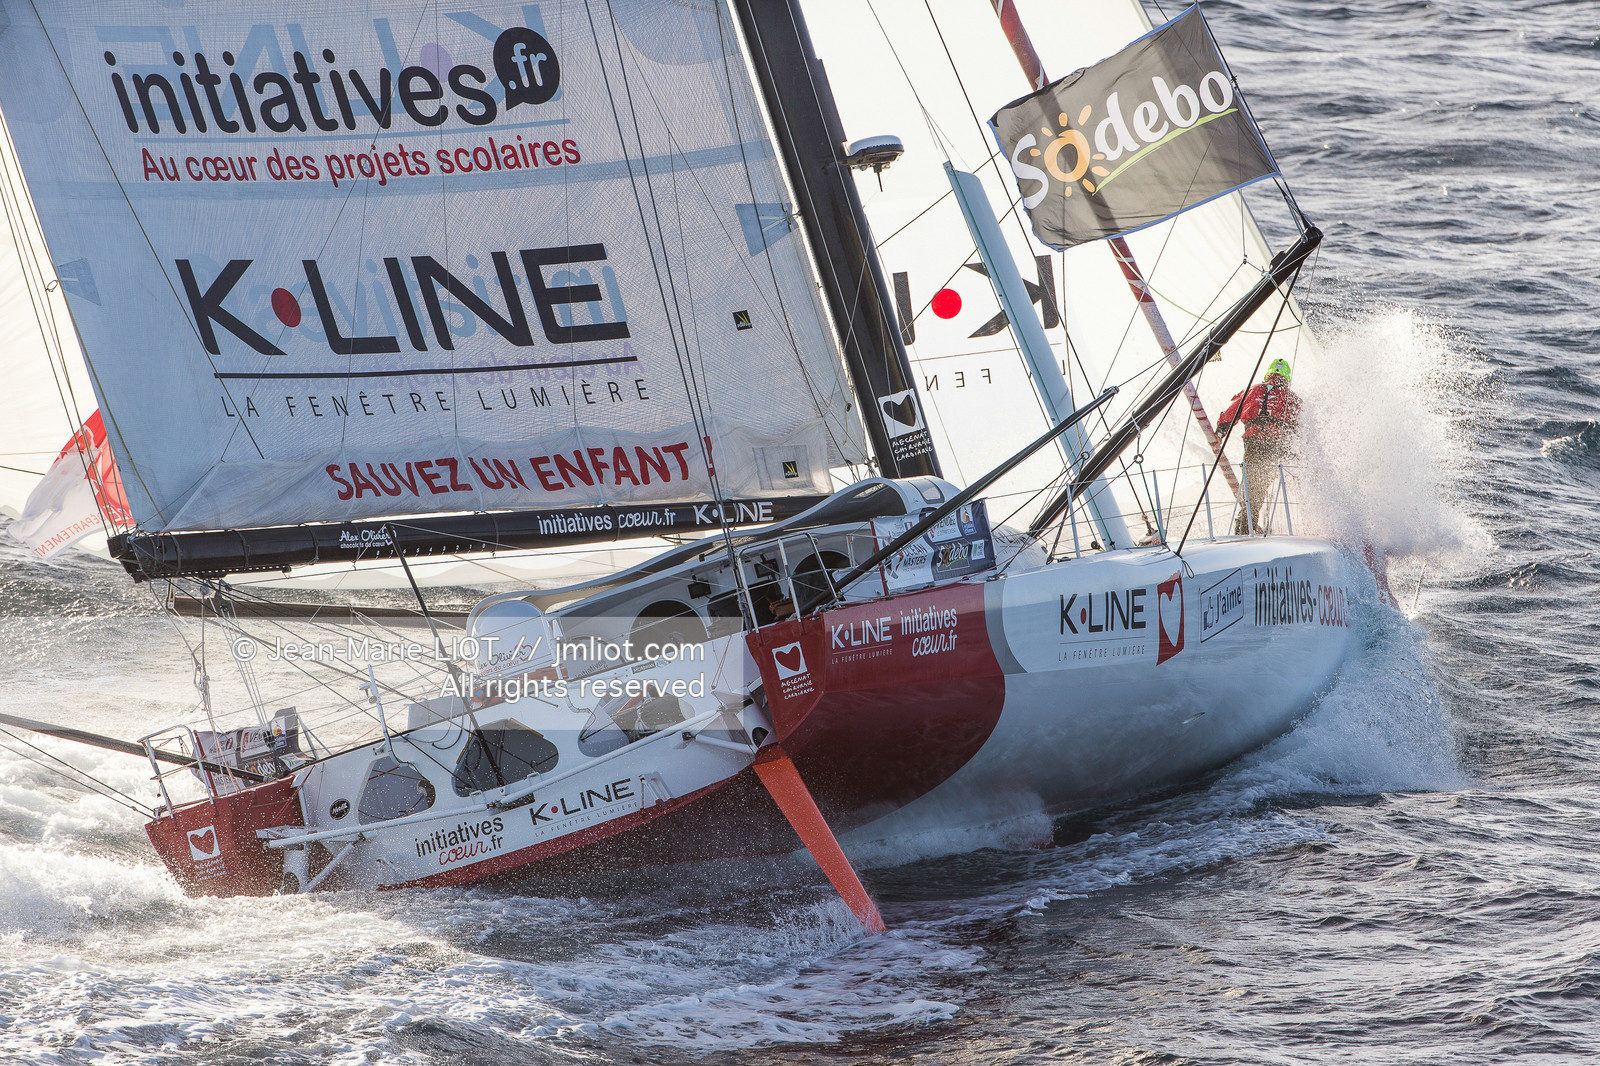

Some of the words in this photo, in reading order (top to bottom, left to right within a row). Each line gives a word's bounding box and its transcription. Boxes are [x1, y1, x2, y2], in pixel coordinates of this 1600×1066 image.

[1011, 70, 1234, 210] Sodebo
[141, 147, 181, 182] Au
[266, 147, 321, 181] des
[325, 144, 431, 188] projets
[436, 135, 581, 174] scolaires
[221, 396, 260, 418] LA
[285, 391, 451, 418] FENÊTRE
[477, 379, 650, 411] LUMIÈRE
[325, 457, 474, 501] SAUVEZ
[468, 457, 532, 492] UN
[529, 441, 689, 492] ENFANT
[537, 512, 613, 535] initiatives
[900, 604, 958, 636] initiatives
[1215, 586, 1242, 624] J'aime
[414, 816, 504, 857] initiatives
